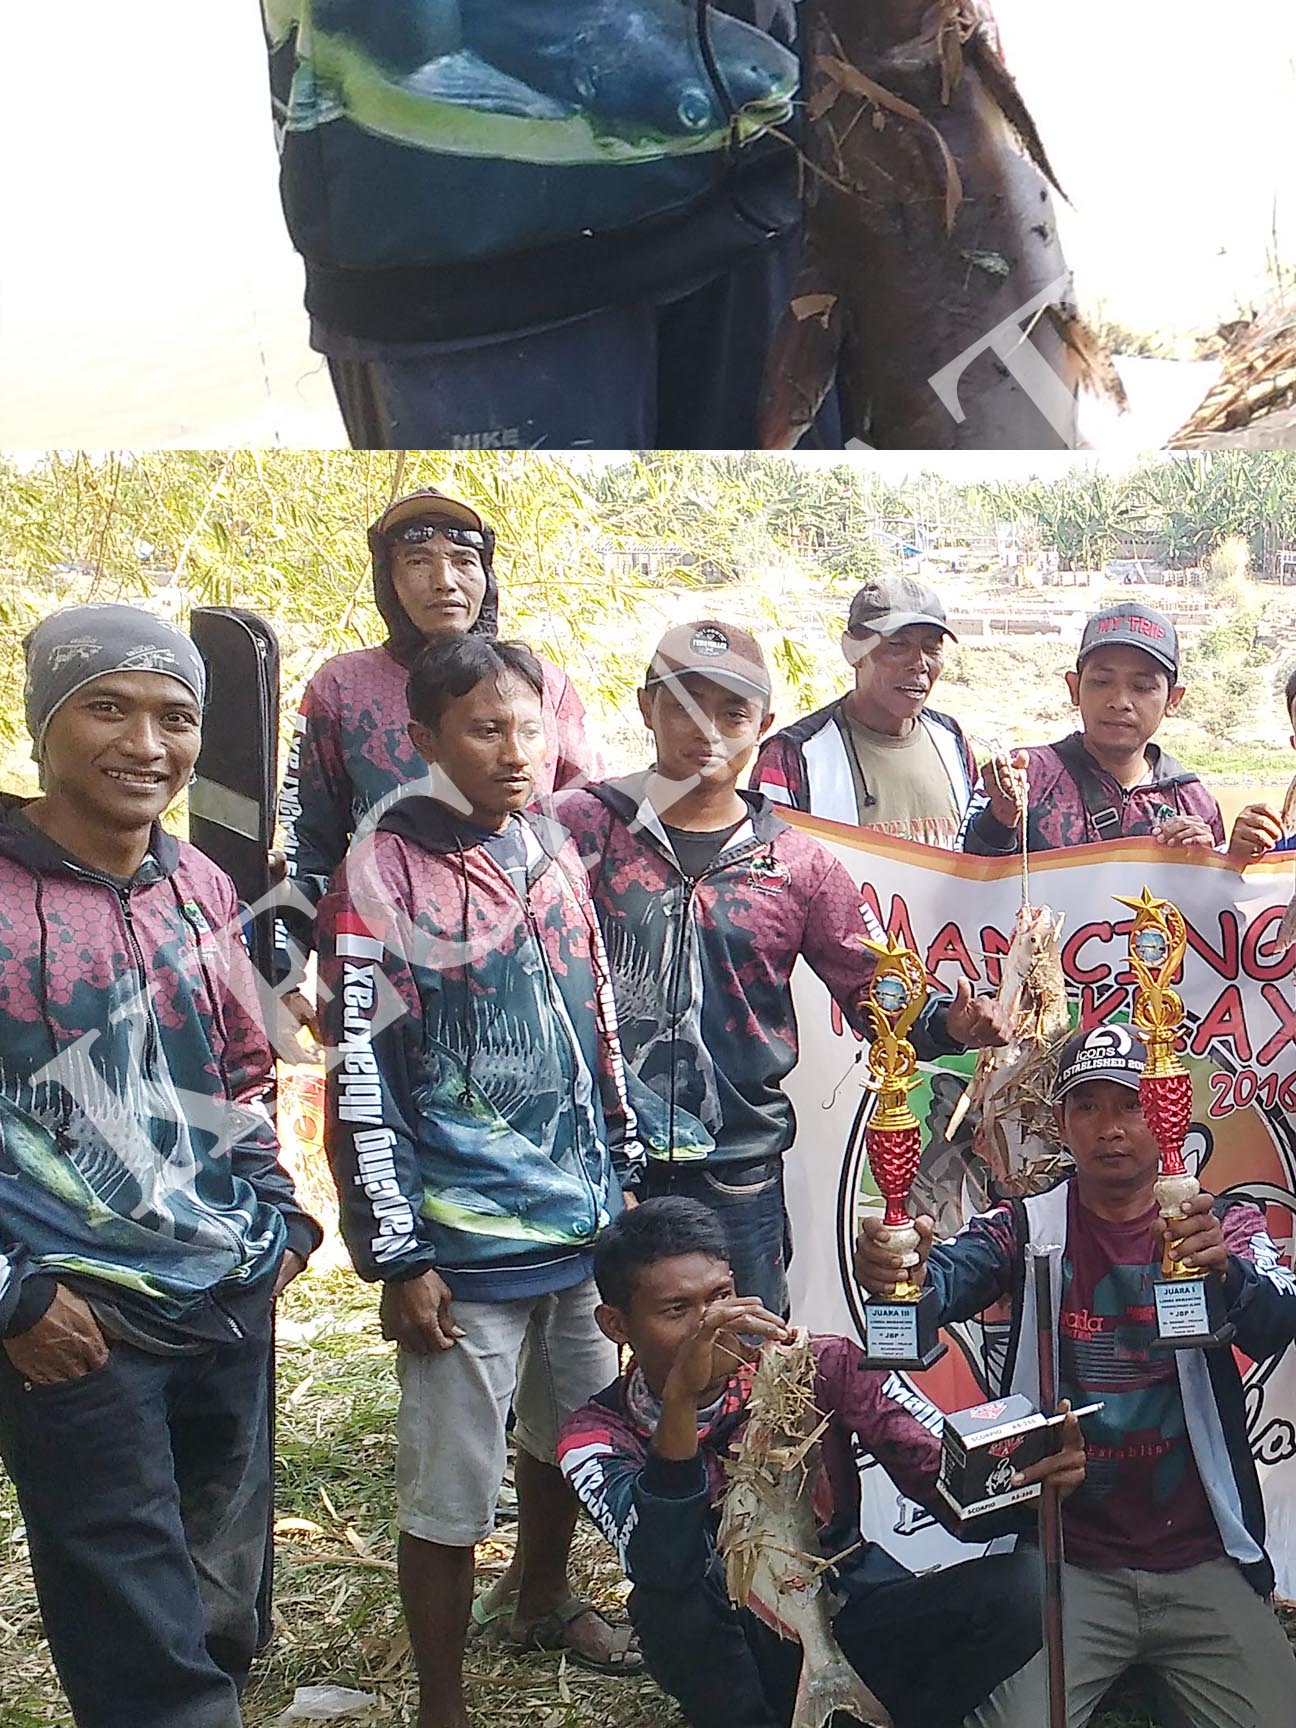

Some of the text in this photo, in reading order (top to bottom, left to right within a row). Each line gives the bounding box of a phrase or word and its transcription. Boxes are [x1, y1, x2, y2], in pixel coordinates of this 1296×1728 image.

[452, 429, 520, 450] NIKE
[1127, 616, 1166, 641] TRIP
[1163, 1287, 1190, 1296] JUARA
[967, 1501, 996, 1515] SCORPIO
